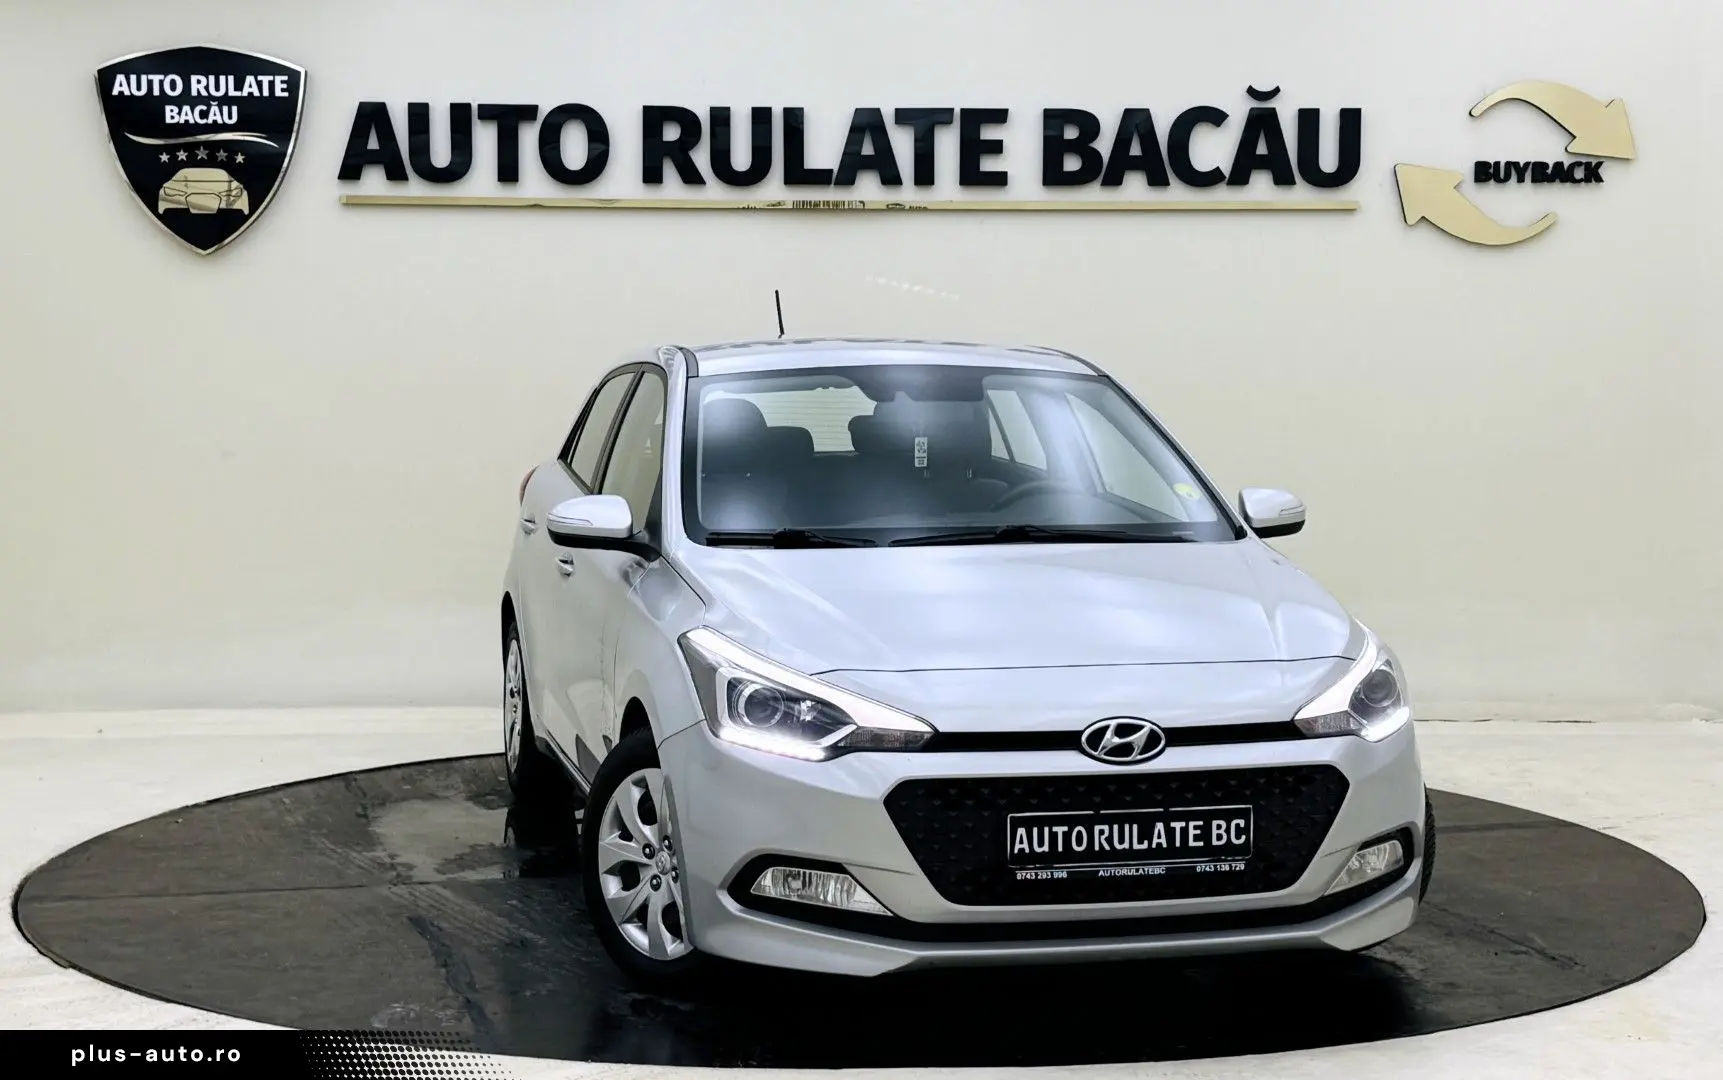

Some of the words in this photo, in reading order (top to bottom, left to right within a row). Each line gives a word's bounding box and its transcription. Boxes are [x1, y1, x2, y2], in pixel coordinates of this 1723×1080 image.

[112, 74, 184, 97] AUTO
[190, 75, 289, 98] RULATE
[165, 101, 238, 125] BACĂU
[338, 102, 609, 187] AUTO
[643, 106, 1009, 187] RULATE
[1042, 85, 1362, 188] BACĂU
[1474, 160, 1605, 184] BUYBACK
[1014, 826, 1088, 854] AUTO
[1094, 824, 1204, 850] RULATE
[1211, 819, 1246, 846] BC
[1098, 867, 1166, 877] AUTORULATEBC
[1196, 864, 1214, 873] 0743
